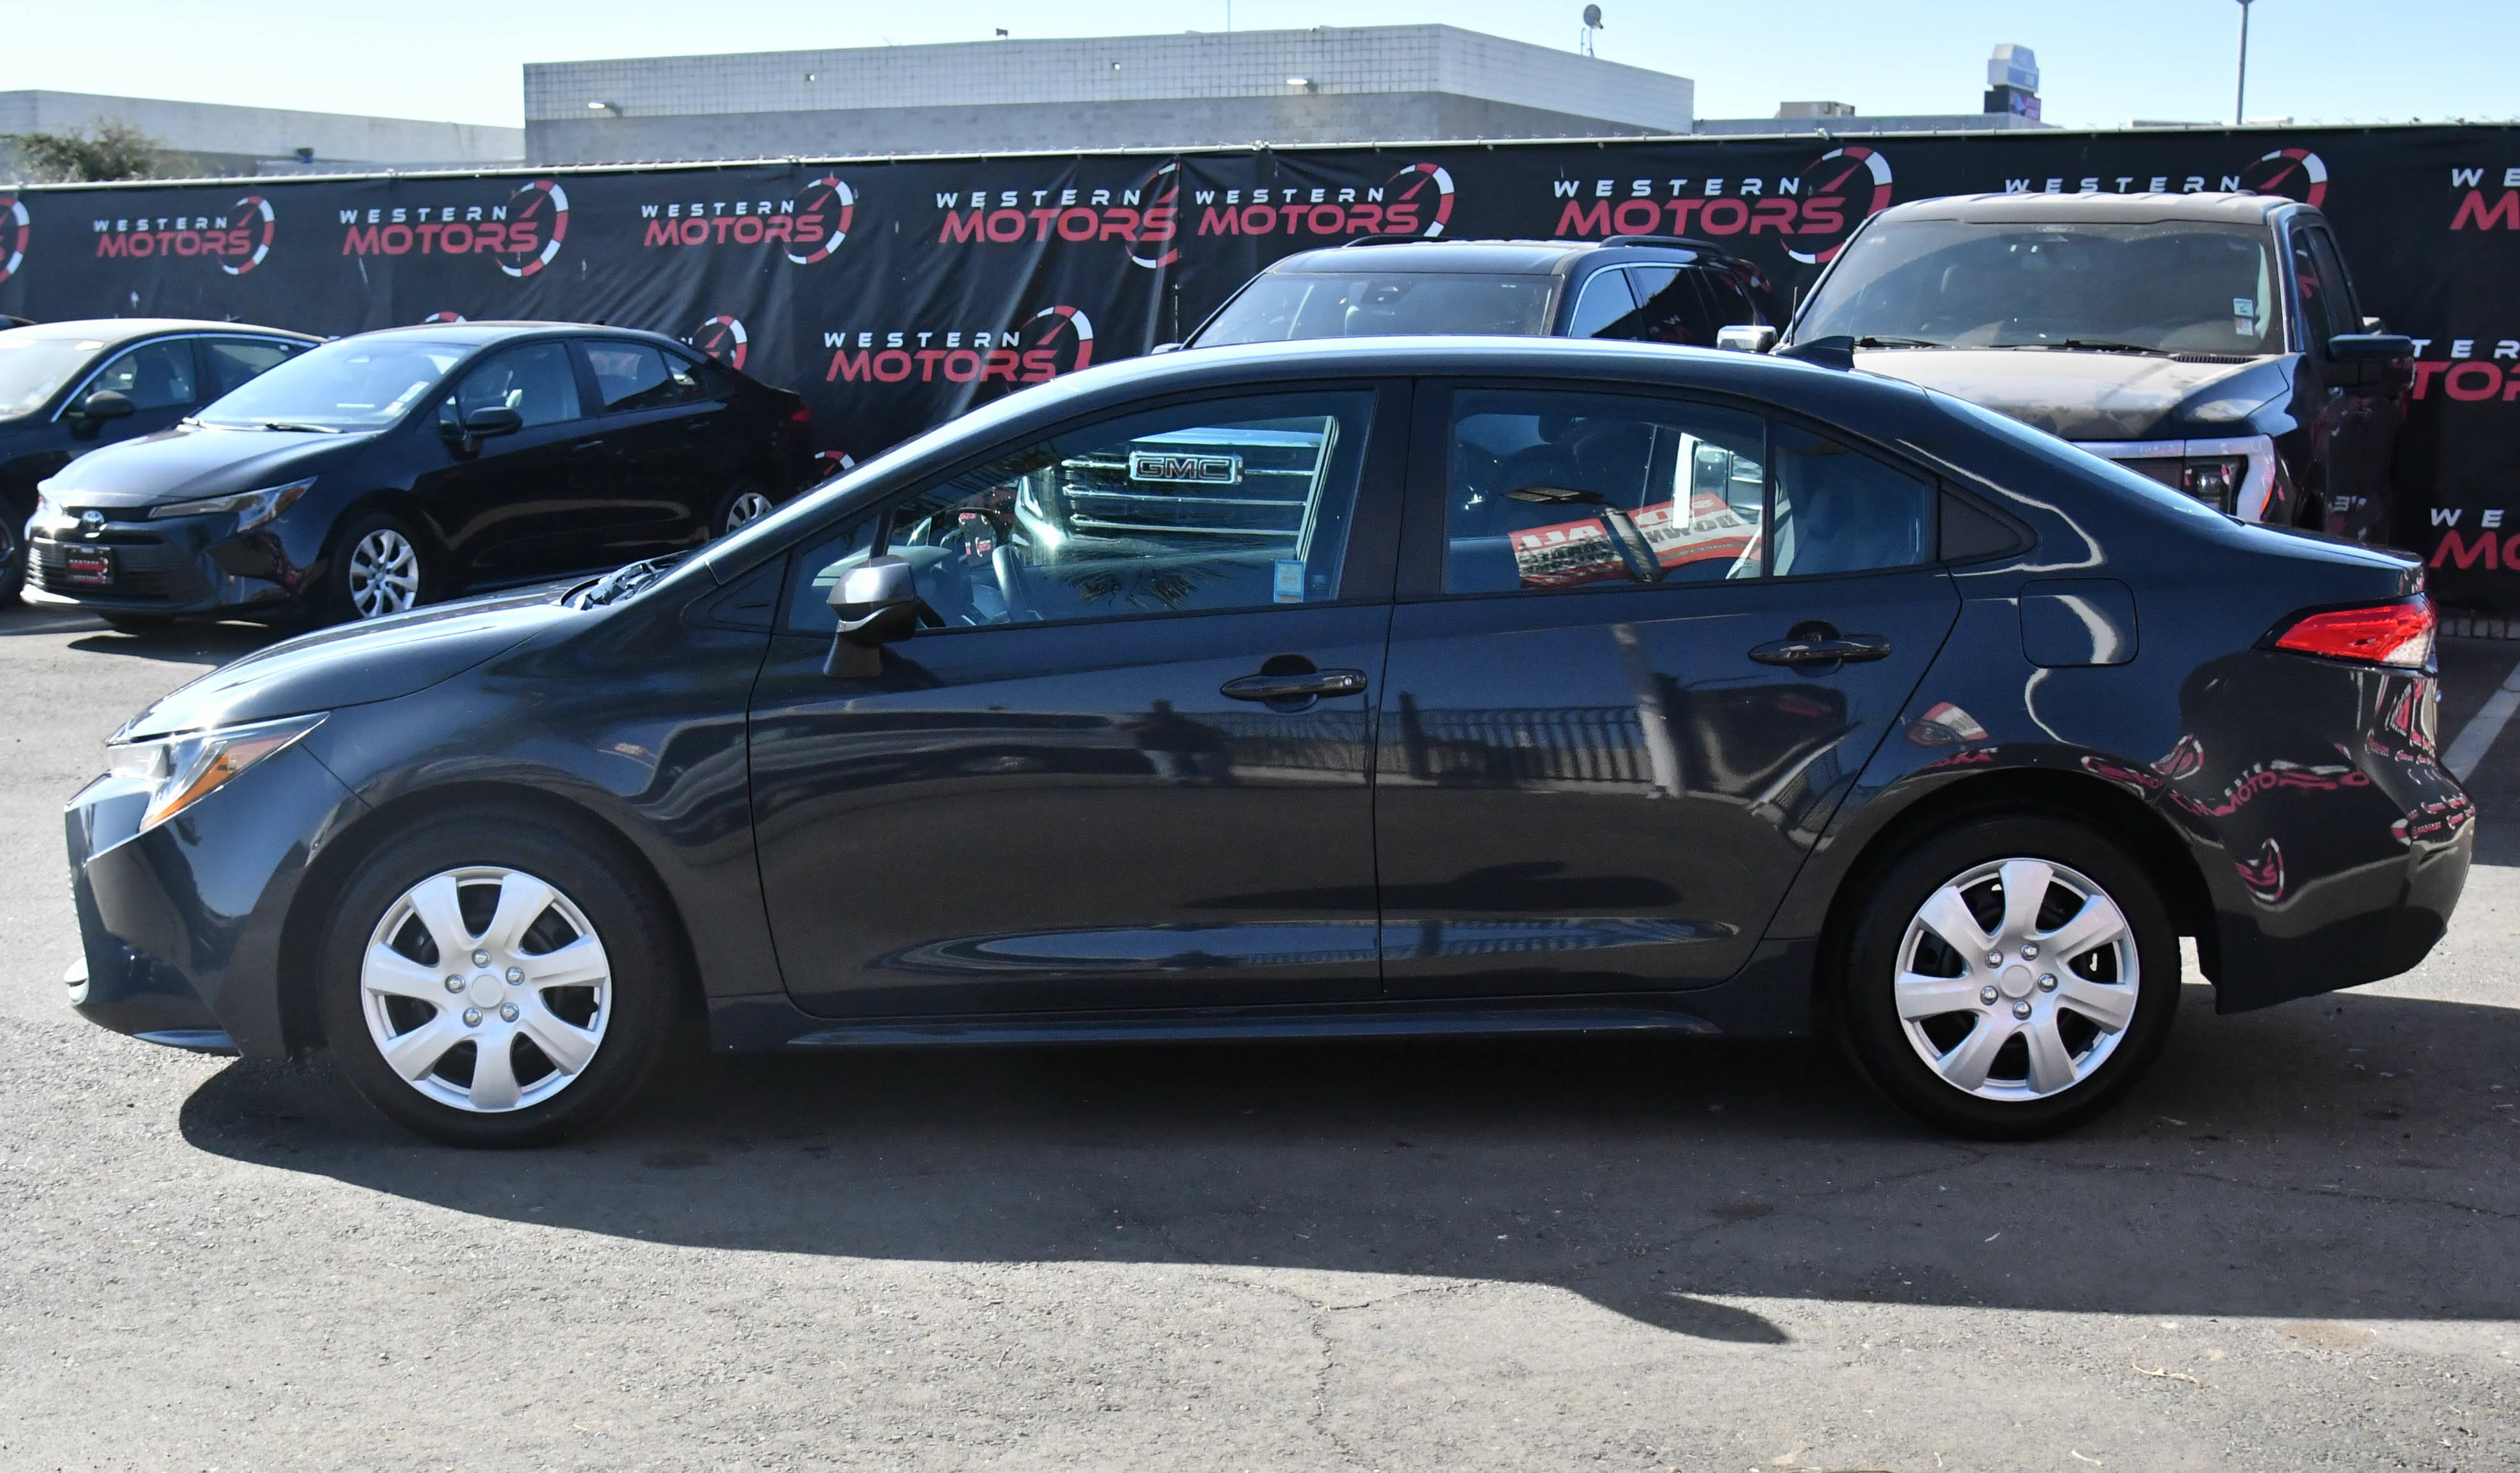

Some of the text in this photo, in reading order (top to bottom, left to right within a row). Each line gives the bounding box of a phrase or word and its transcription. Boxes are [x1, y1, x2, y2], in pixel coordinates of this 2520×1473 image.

[1554, 177, 1800, 197] WESTERN
[2005, 176, 2240, 194] WESTERN
[936, 189, 1141, 209] WESTERN
[1195, 187, 1384, 206] WESTERN
[339, 206, 507, 224] WESTERN
[641, 200, 794, 218] WESTERN
[1197, 203, 1420, 236] MOTORS
[1555, 196, 1847, 236] MOTORS
[93, 216, 227, 233] WESTERN
[644, 214, 824, 246] MOTORS
[938, 207, 1178, 243] MOTORS
[96, 229, 251, 258] MOTORS
[342, 221, 538, 256] MOTORS
[824, 332, 1020, 348] WESTERN
[826, 349, 1058, 383] MOTORS
[1137, 457, 1229, 480] GMC
